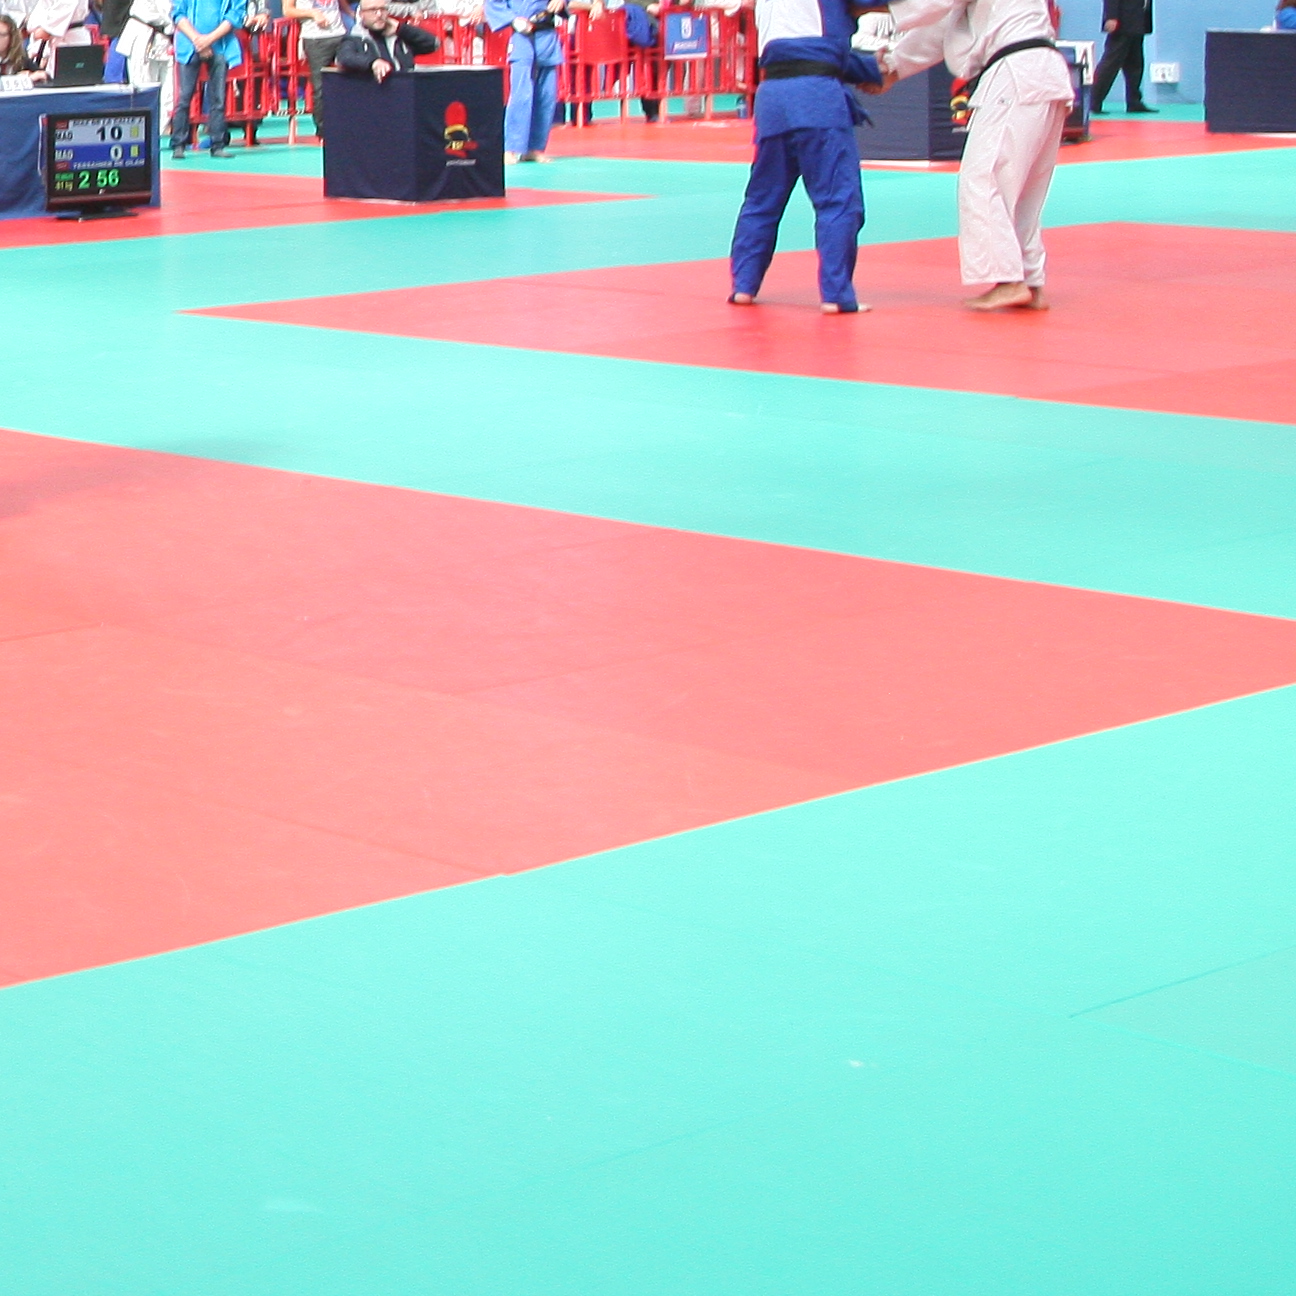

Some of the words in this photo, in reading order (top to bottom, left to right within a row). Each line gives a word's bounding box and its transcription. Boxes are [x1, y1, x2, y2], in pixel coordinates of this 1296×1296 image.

[96, 125, 122, 141] 10
[55, 149, 73, 161] MAD
[110, 145, 123, 160] 0
[78, 170, 90, 189] 2
[97, 169, 120, 187] 56
